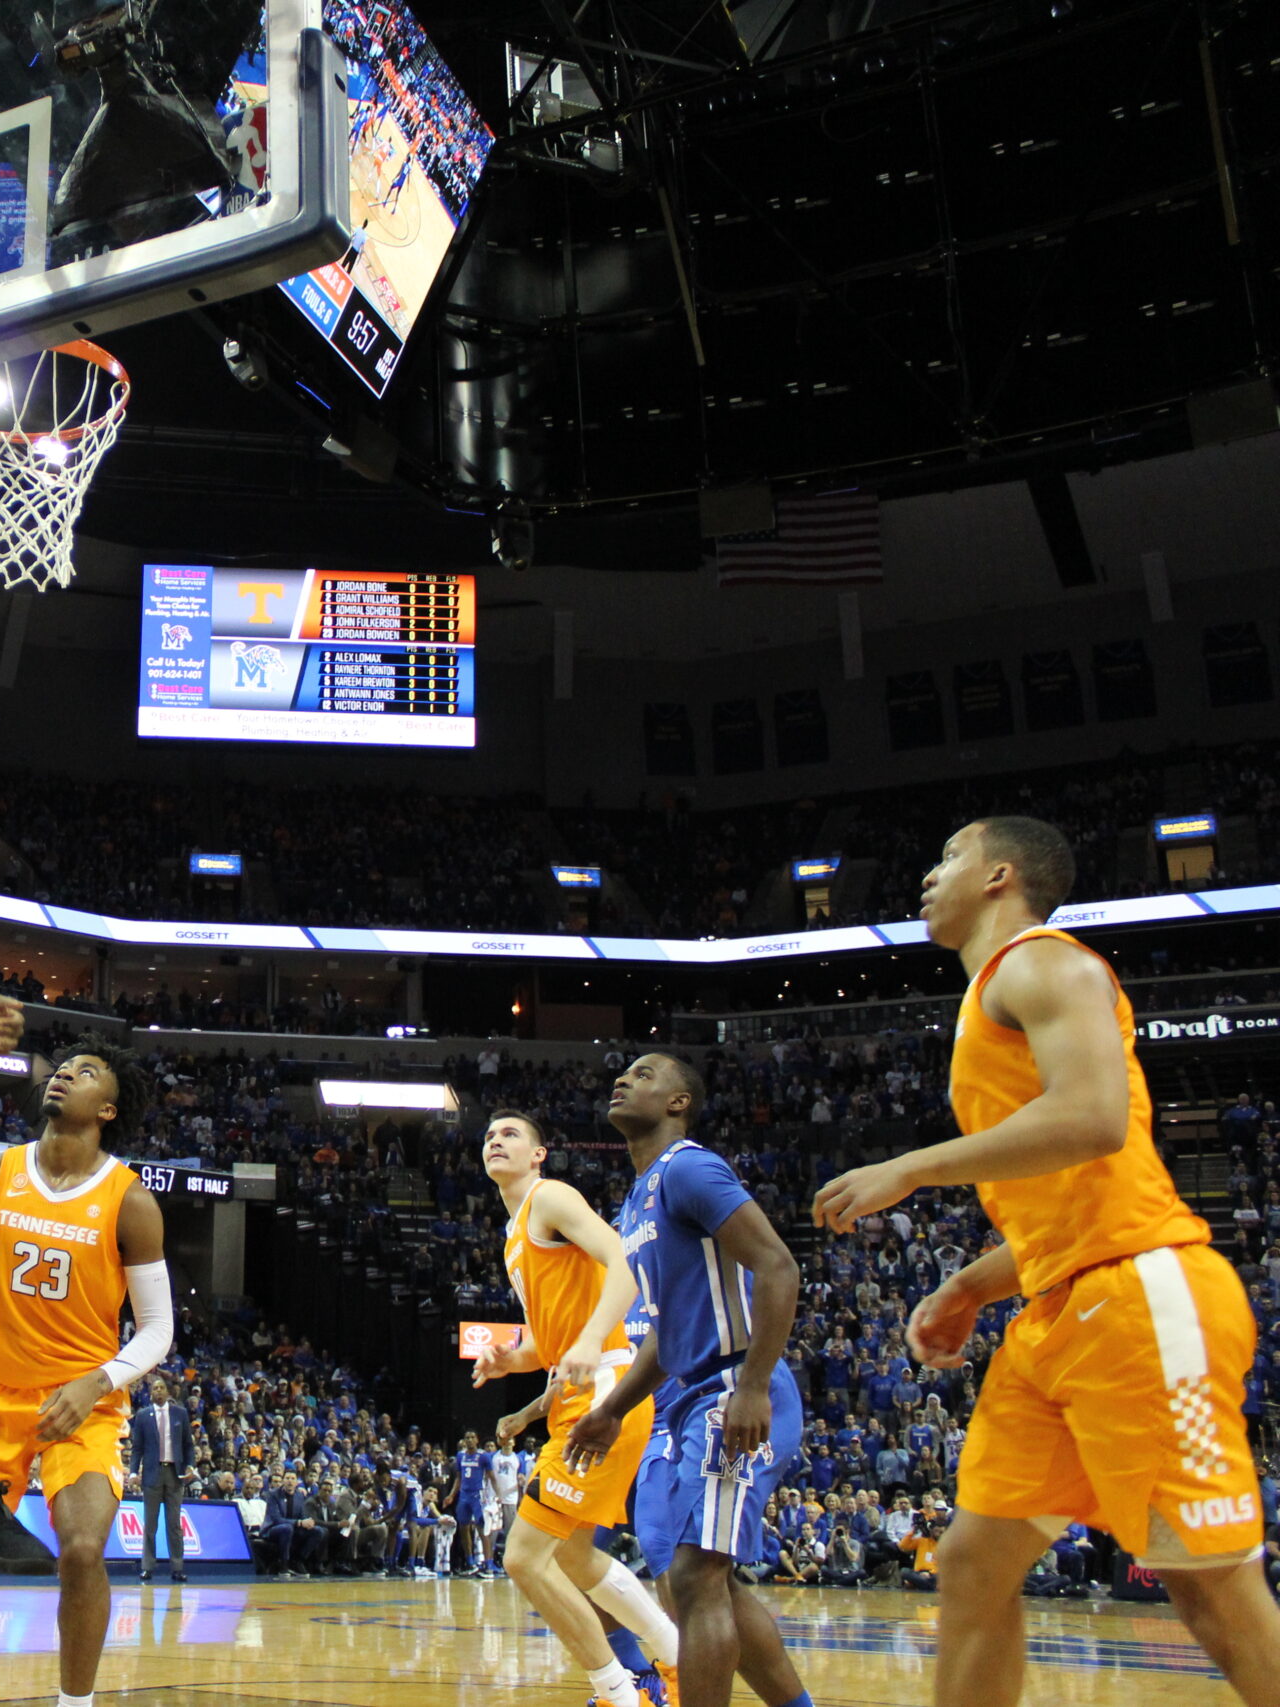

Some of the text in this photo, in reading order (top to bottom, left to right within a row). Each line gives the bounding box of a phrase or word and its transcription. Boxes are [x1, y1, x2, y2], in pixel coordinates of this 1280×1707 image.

[226, 192, 250, 215] NBA
[348, 310, 379, 355] 9:57
[335, 581, 365, 591] JORDAN
[367, 582, 387, 592] BONE
[238, 582, 284, 624] T
[336, 593, 362, 603] GRANT
[363, 594, 399, 604] WILLIAMS
[335, 605, 364, 615] ADMIRAL
[365, 605, 401, 616] SCHOFIELD
[335, 617, 356, 627] JOHN
[356, 618, 401, 628] FULKERSON
[335, 628, 365, 639] JORDAN
[366, 630, 399, 640] BOWDEN
[146, 657, 205, 669] Call Us Today!
[335, 653, 354, 662] ALEX
[355, 653, 381, 663] LOMAX
[335, 664, 363, 674] RAYNERE
[364, 665, 395, 676] THORNTON
[335, 676, 363, 687] KAREEM
[363, 677, 395, 687] BREWTON
[334, 688, 371, 699] ANTWANN
[372, 689, 395, 700] JONES
[334, 701, 362, 711] VICTOR
[363, 701, 384, 712] ENOH
[1045, 911, 1106, 925] GOSSETT
[175, 931, 229, 941] GOSSETT
[472, 941, 526, 951] GOSSETT
[747, 941, 801, 954] GOSSETT
[1148, 1014, 1277, 1040] Draft ROOM
[440, 1110, 456, 1120] 102
[141, 1165, 176, 1193] 9:57
[204, 1178, 229, 1195] HALF
[11, 1241, 72, 1301] 23
[545, 1477, 585, 1504] VOLS
[1178, 1492, 1257, 1529] VOLS
